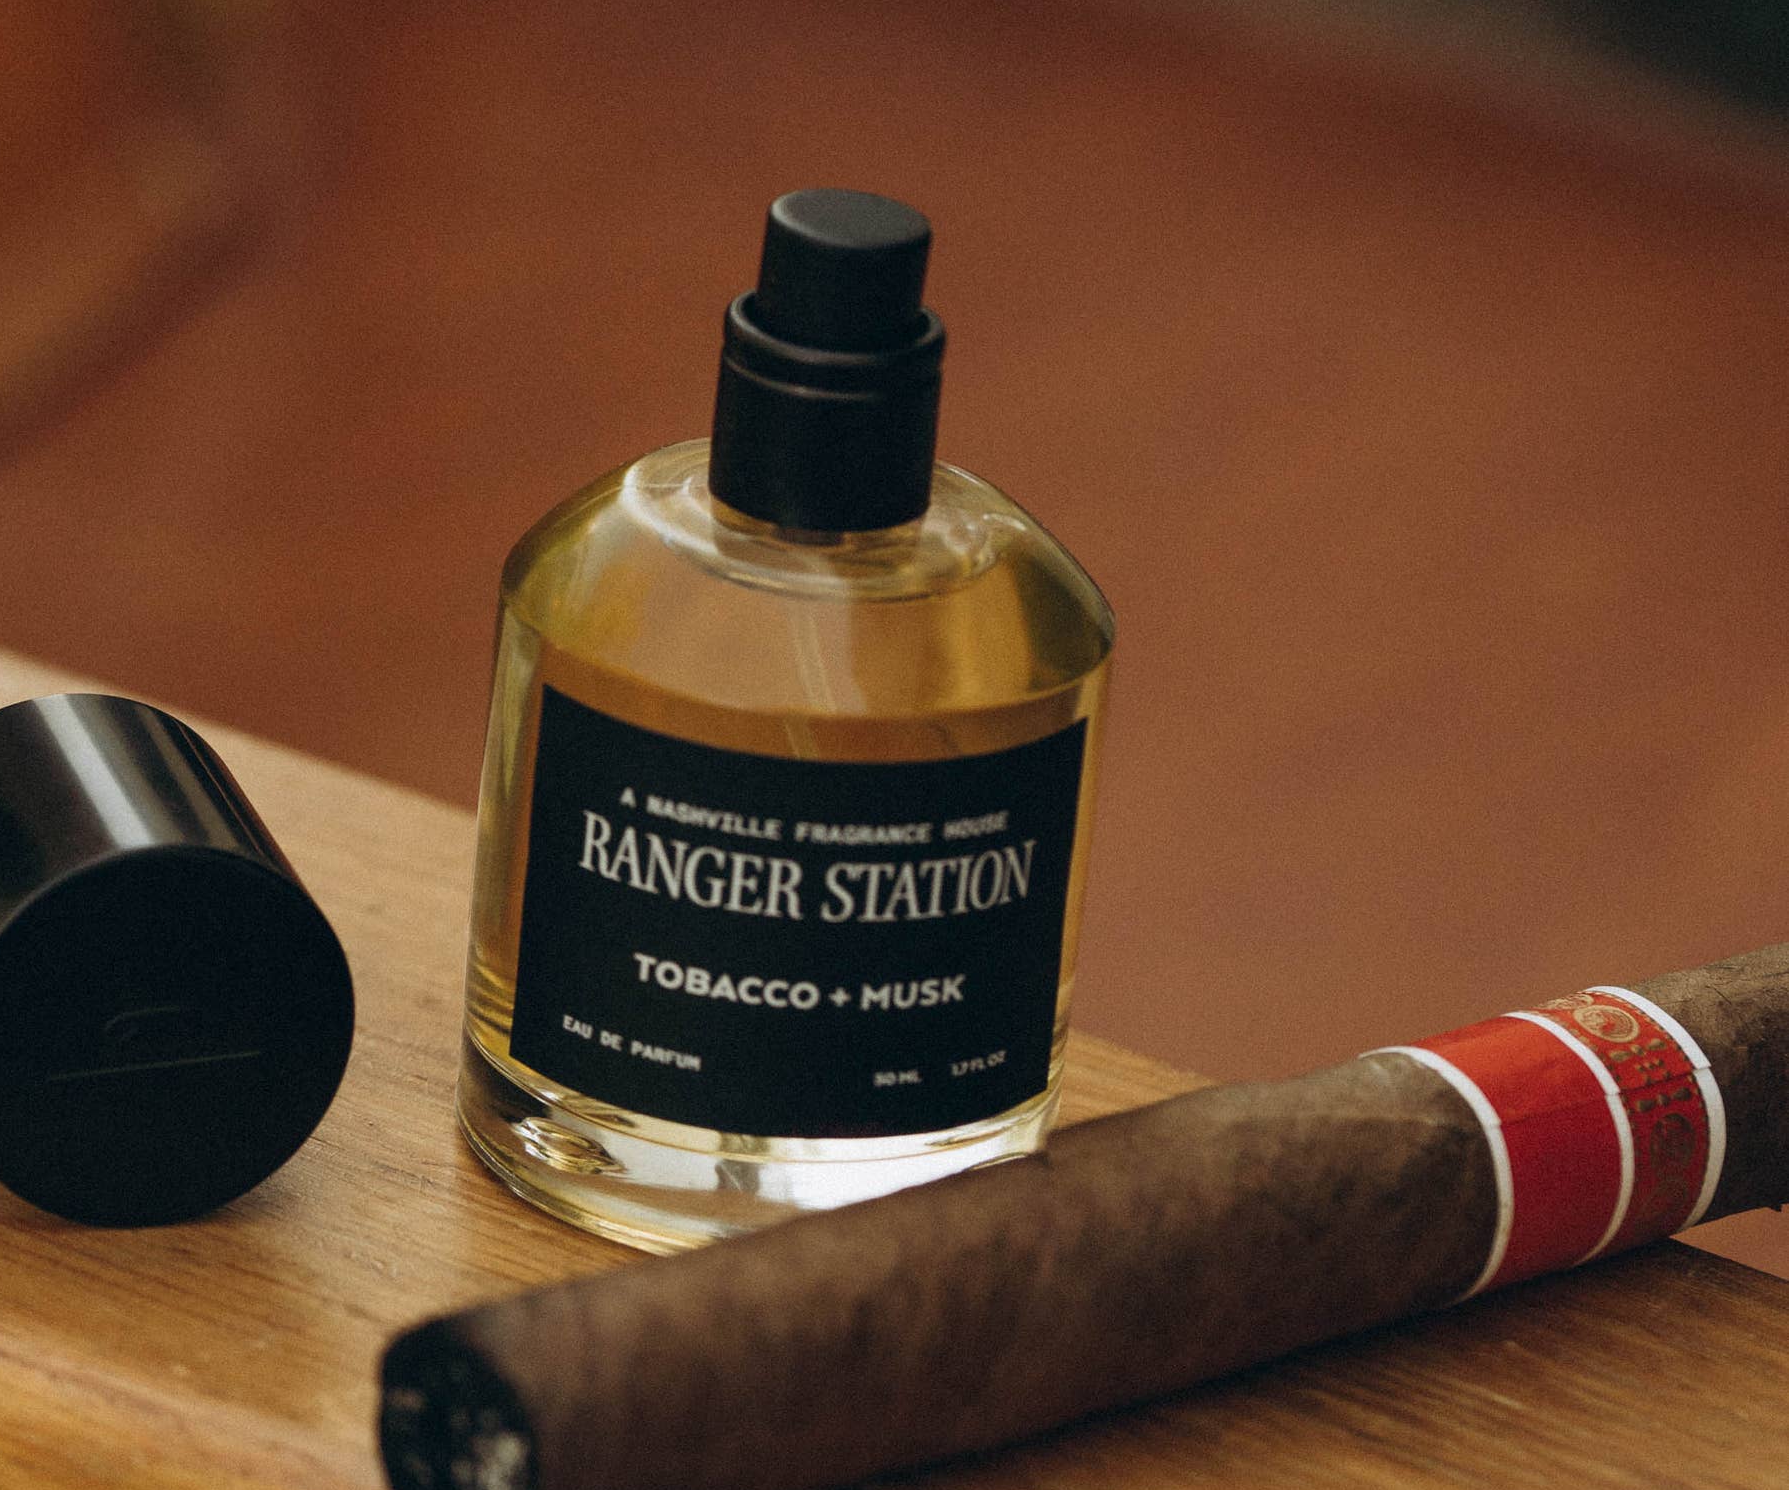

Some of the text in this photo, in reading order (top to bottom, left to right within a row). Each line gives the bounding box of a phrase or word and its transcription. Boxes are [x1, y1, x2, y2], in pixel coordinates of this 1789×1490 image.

[620, 787, 637, 807] A
[646, 795, 782, 841] NASHVILLE
[795, 821, 932, 845] FRAGRANCE
[578, 810, 1036, 923] RANGER STATION
[633, 952, 966, 1011] TOBACCO + MUSK
[562, 1014, 702, 1072] EAU DE PARFUM
